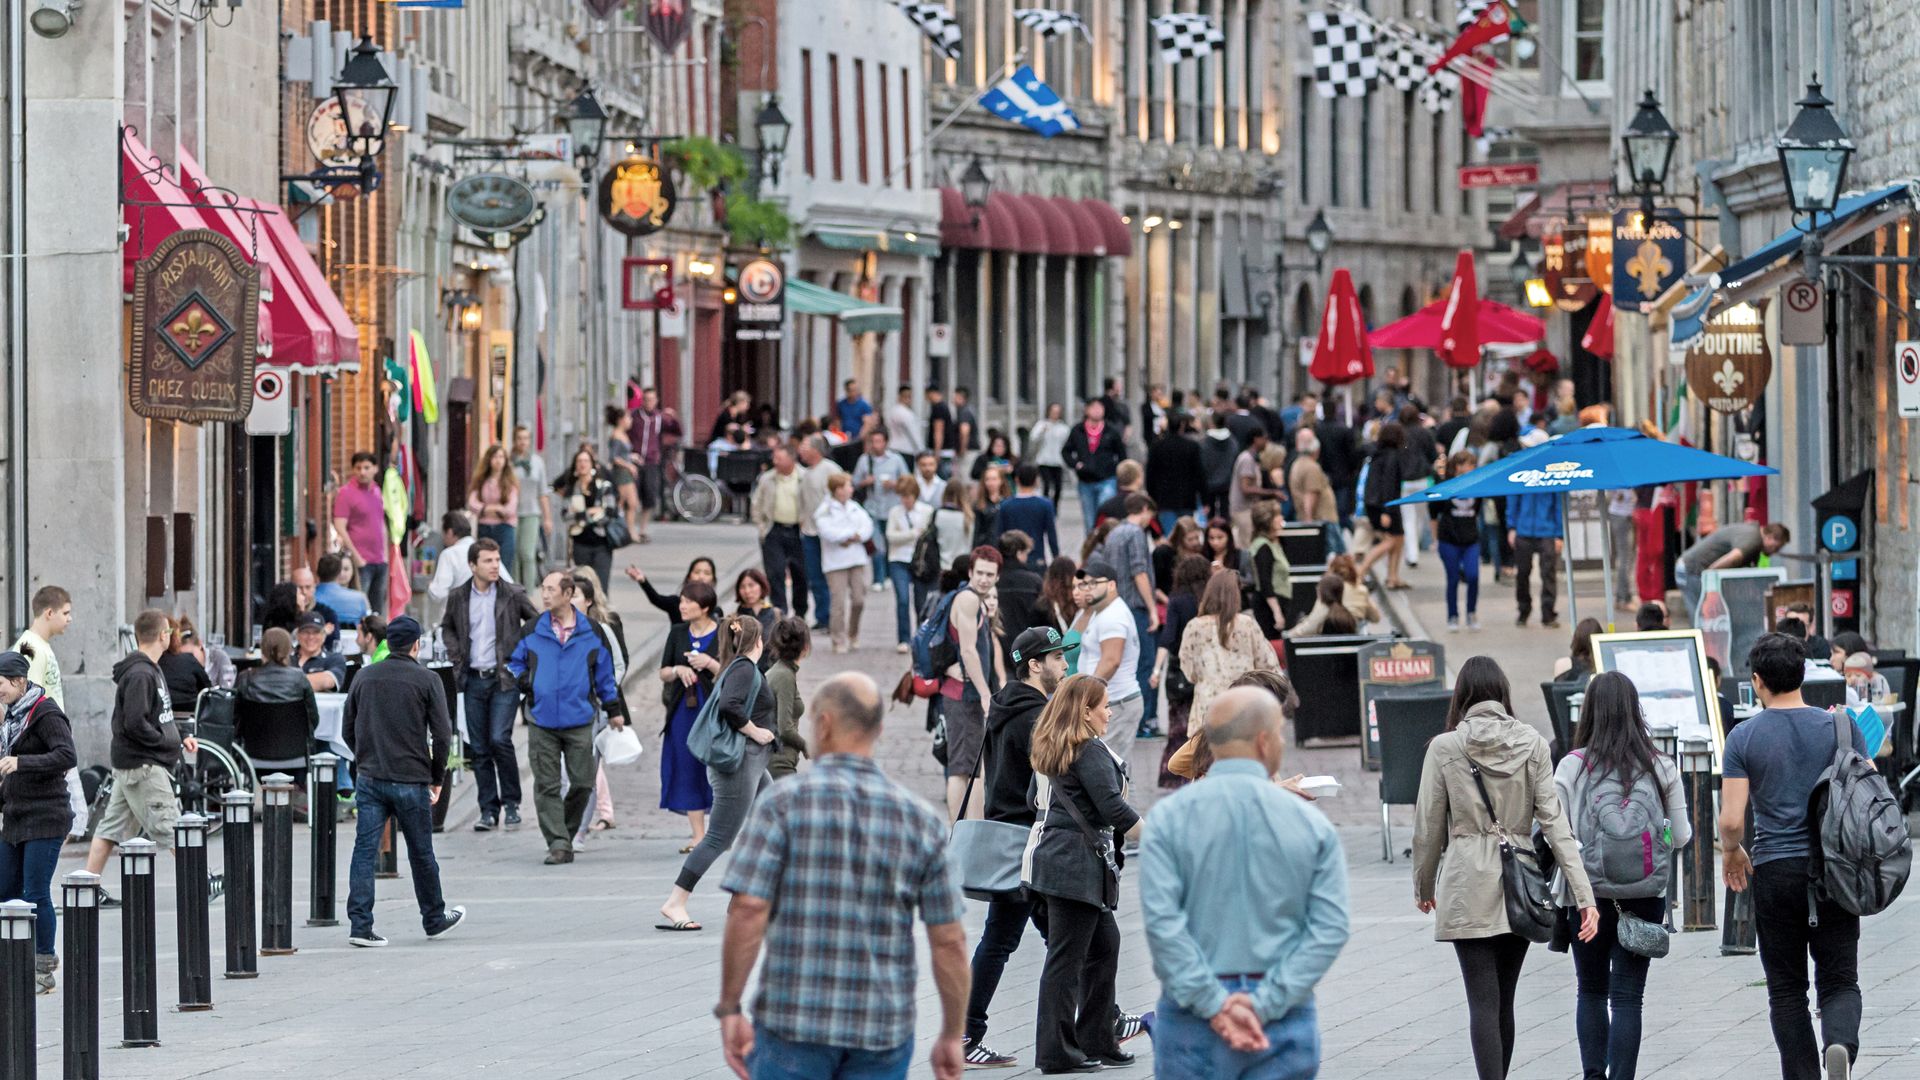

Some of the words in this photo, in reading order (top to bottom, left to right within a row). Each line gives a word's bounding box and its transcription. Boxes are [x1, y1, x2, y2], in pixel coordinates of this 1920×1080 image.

[161, 249, 236, 291] RESTAURANT
[1692, 333, 1763, 355] POUTINE
[149, 378, 185, 399] CHEZ
[191, 380, 237, 401] QUEUX
[1508, 469, 1595, 483] Corona
[1524, 479, 1571, 487] Extra
[1831, 522, 1847, 545] P
[1373, 660, 1431, 677] SLEEMAN
